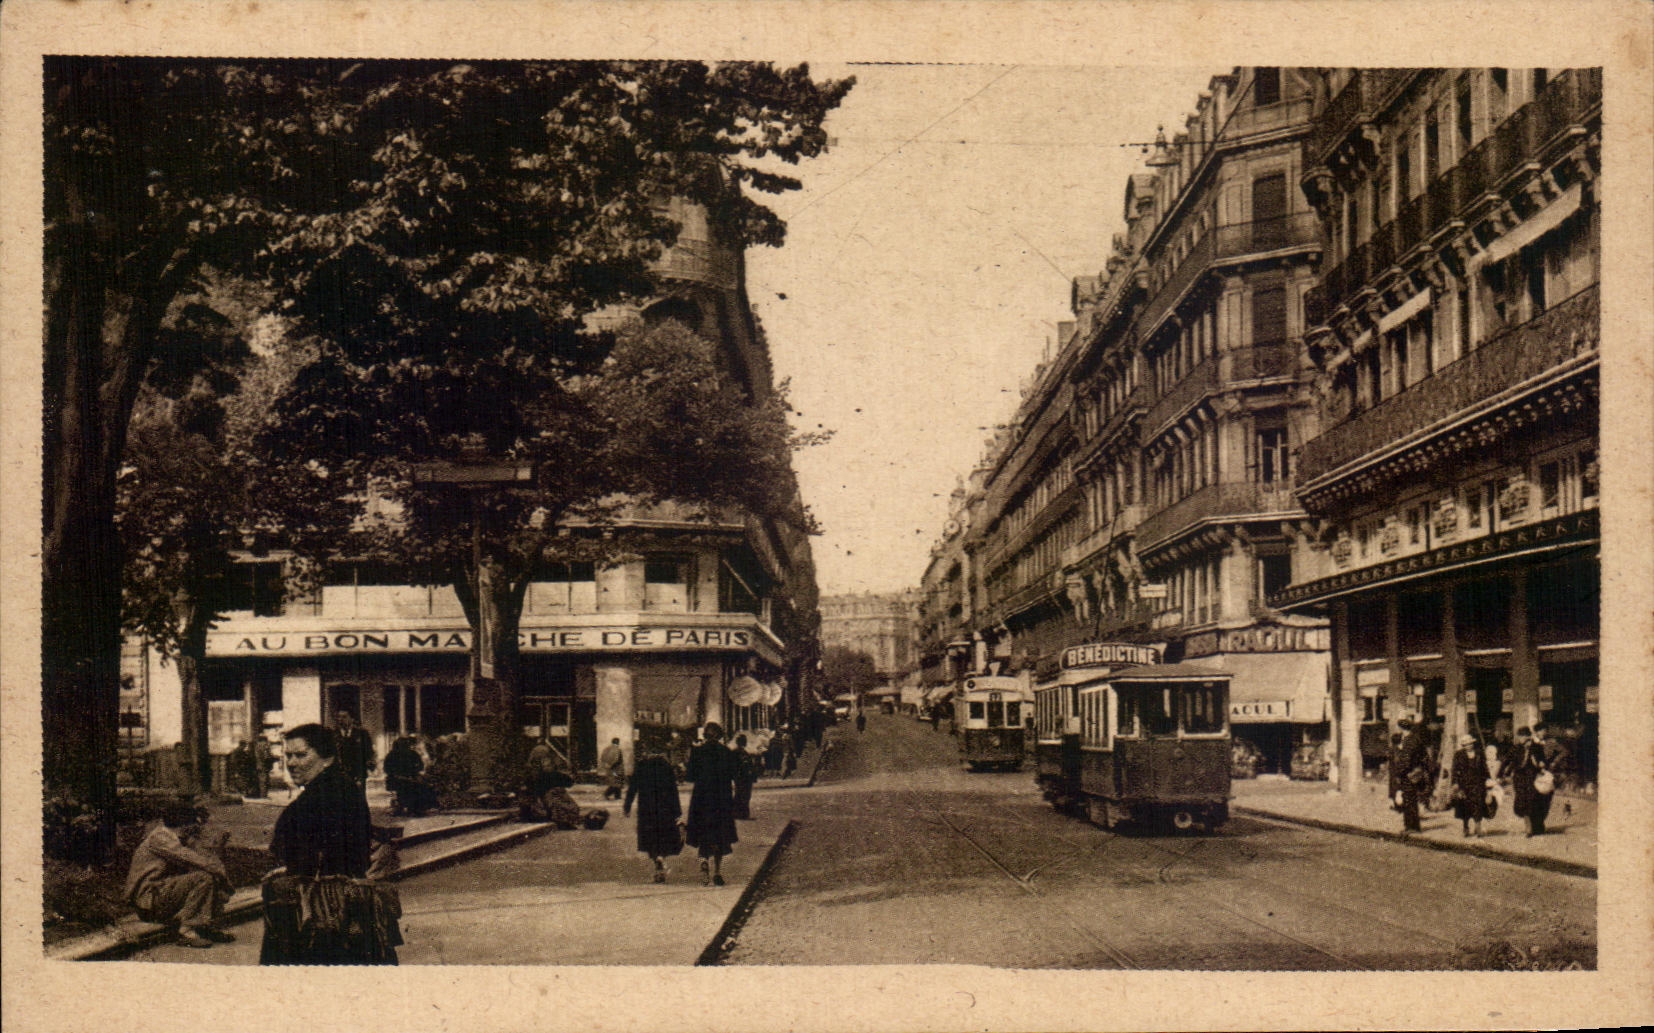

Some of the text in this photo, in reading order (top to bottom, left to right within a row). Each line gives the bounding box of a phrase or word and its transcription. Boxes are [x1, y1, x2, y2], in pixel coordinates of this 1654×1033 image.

[235, 629, 749, 651] AU BON MAHE DE PARIS
